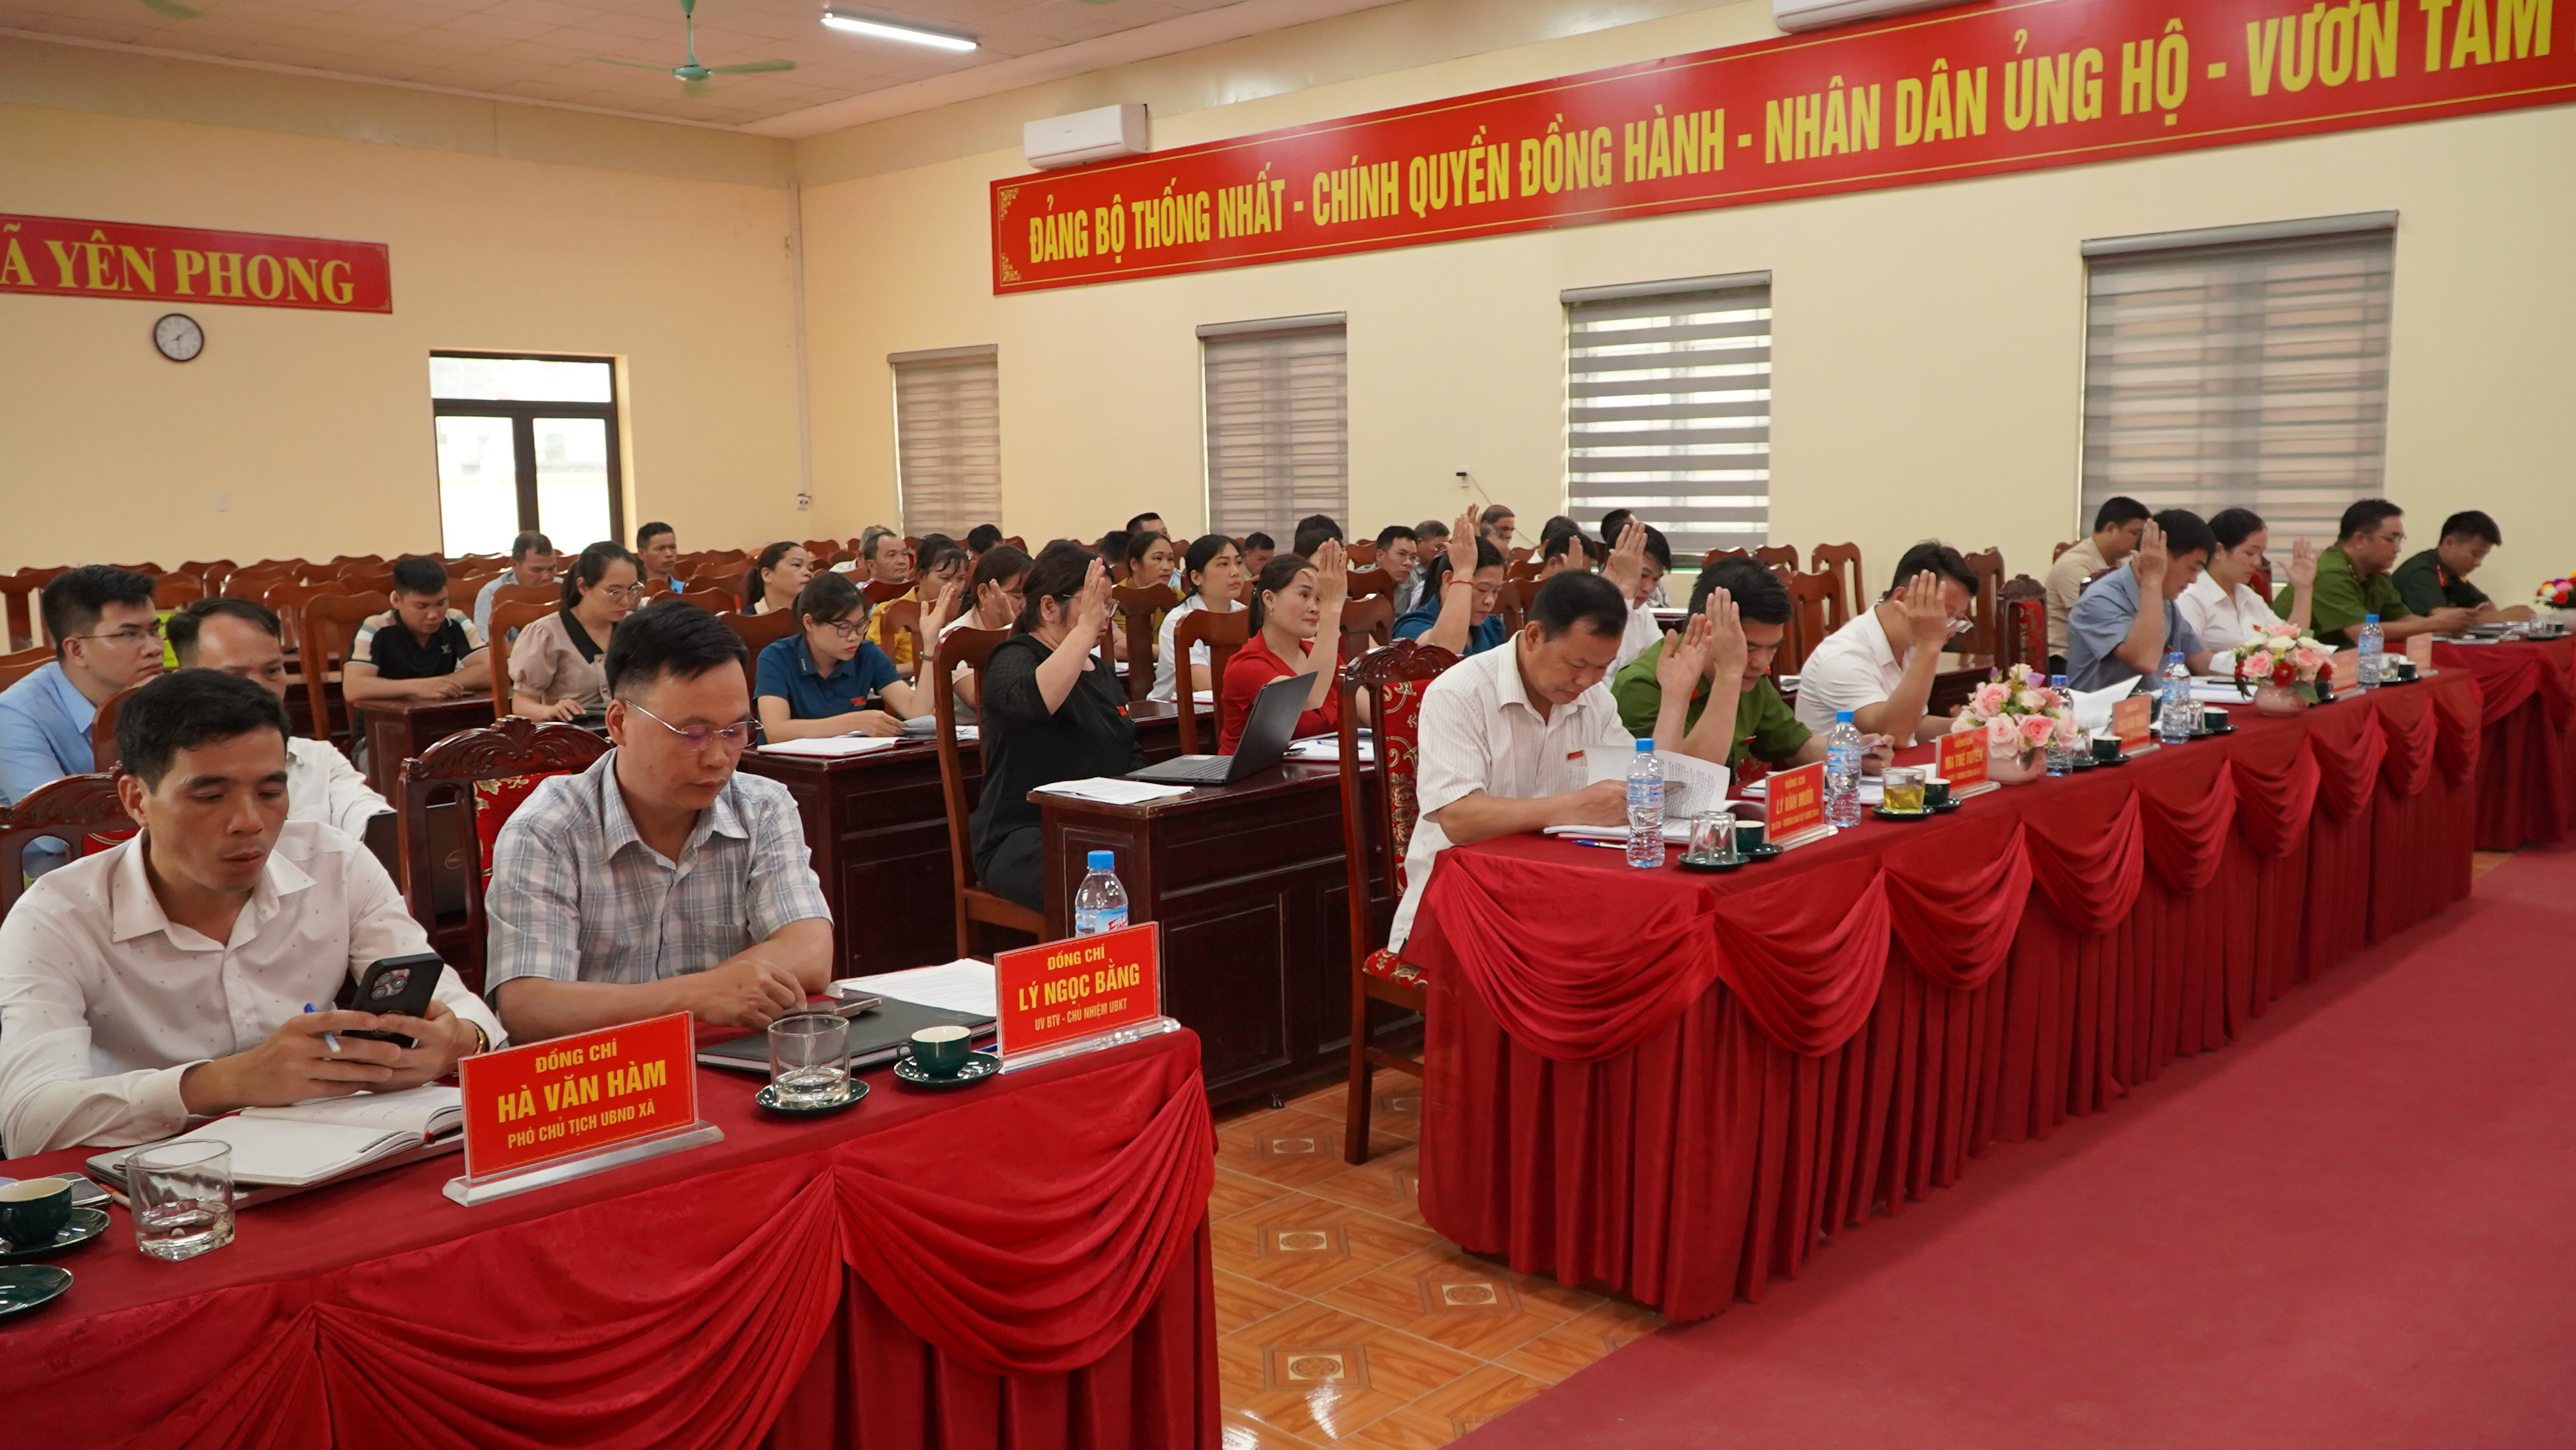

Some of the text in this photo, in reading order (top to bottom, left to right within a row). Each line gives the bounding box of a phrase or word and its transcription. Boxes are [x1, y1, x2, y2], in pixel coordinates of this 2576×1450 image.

[1029, 194, 1089, 264] ĐẢNG
[1095, 195, 1126, 264] BỘ
[1131, 177, 1211, 250] THỐNG
[1218, 162, 1285, 239] NHẤT
[1293, 200, 1304, 212] -
[1312, 155, 1399, 226] CHÍNH
[1408, 126, 1510, 219] QUYỀN
[1519, 113, 1612, 197] ĐỒNG
[1624, 104, 1725, 183] HÀNH
[1738, 133, 1752, 147] -
[1765, 75, 1881, 164] NHÂN
[1895, 58, 1988, 147] DÂN
[2003, 29, 2103, 132] ỦNG
[2120, 18, 2189, 126] HỘ
[2207, 62, 2227, 79] -
[2246, 0, 2400, 97] VƯƠN
[45, 229, 156, 292] YÊN
[171, 249, 355, 304] PHONG
[1047, 944, 1105, 971] ĐỒNG CHÍ
[1018, 981, 1039, 1012] LÝ
[1044, 974, 1090, 1006] NGỌC
[1094, 958, 1140, 994] BẰNG
[1035, 1017, 1045, 1031] UV
[1047, 1014, 1060, 1029] BTV
[1067, 1004, 1082, 1023] CHỦ
[1084, 1002, 1108, 1019] NHIỆM
[1109, 997, 1128, 1014] UBKT
[535, 1038, 617, 1073] ĐỒNG CHÍ
[497, 1060, 667, 1123] HÀ VĂN HÀM
[507, 1098, 655, 1149] PHÓ CHỦ TỊCH UBND XÃ
